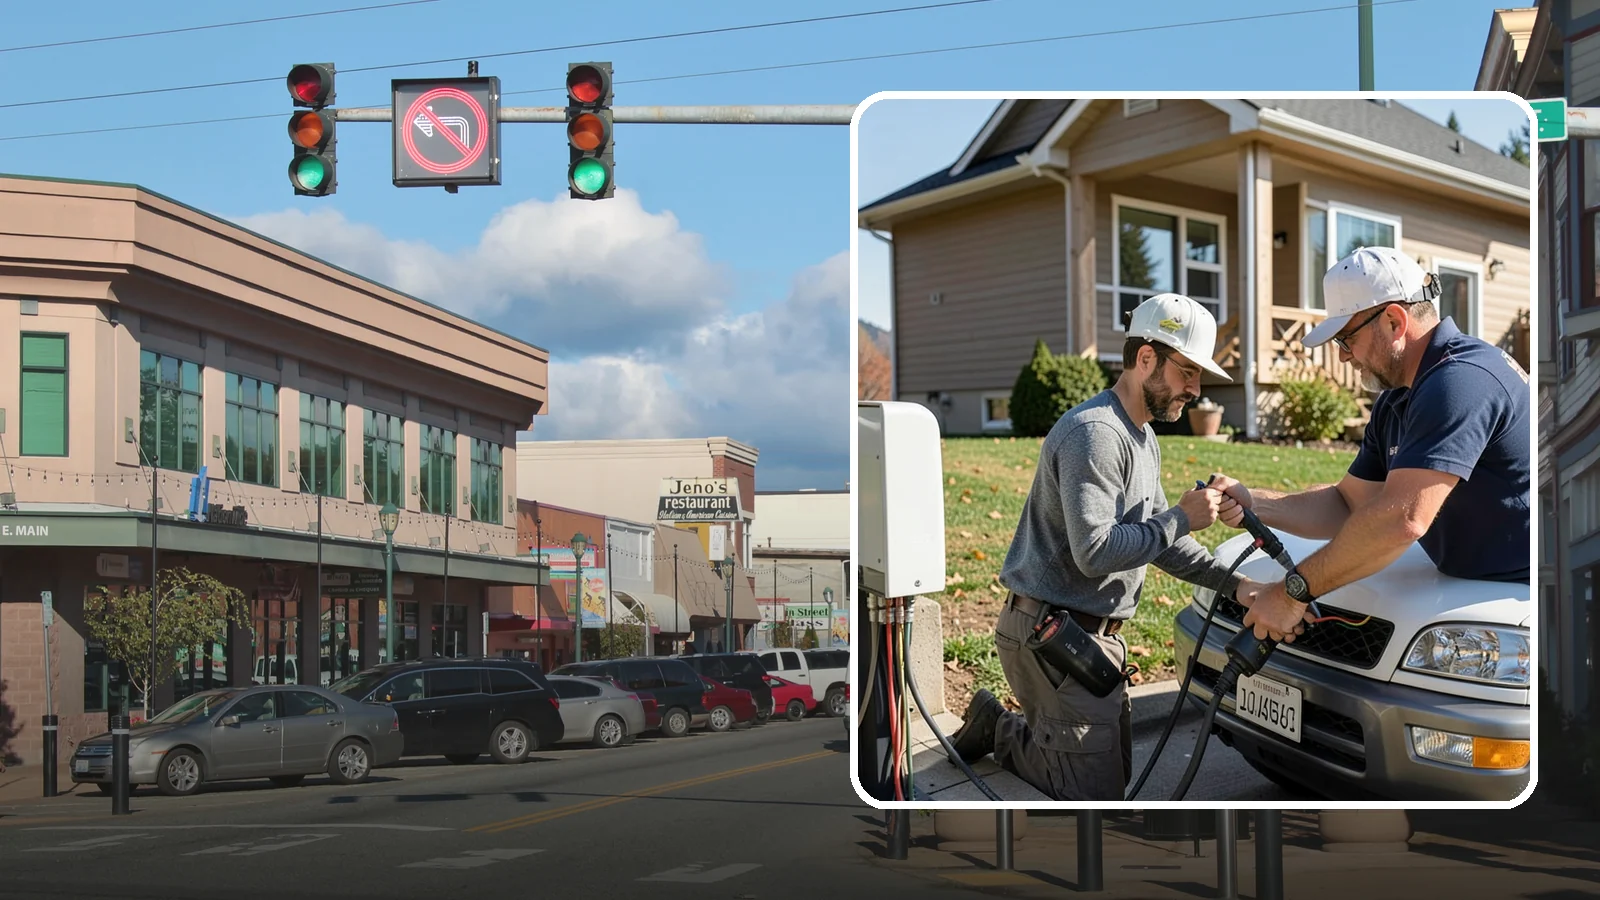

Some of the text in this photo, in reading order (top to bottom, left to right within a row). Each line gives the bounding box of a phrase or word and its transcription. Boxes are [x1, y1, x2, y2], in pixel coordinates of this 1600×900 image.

[669, 480, 728, 495] Jeno's
[665, 496, 731, 509] restaurant
[686, 510, 715, 519] American
[715, 509, 738, 519] Cuisine
[2, 525, 49, 536] E. MAIN
[797, 607, 829, 617] Street
